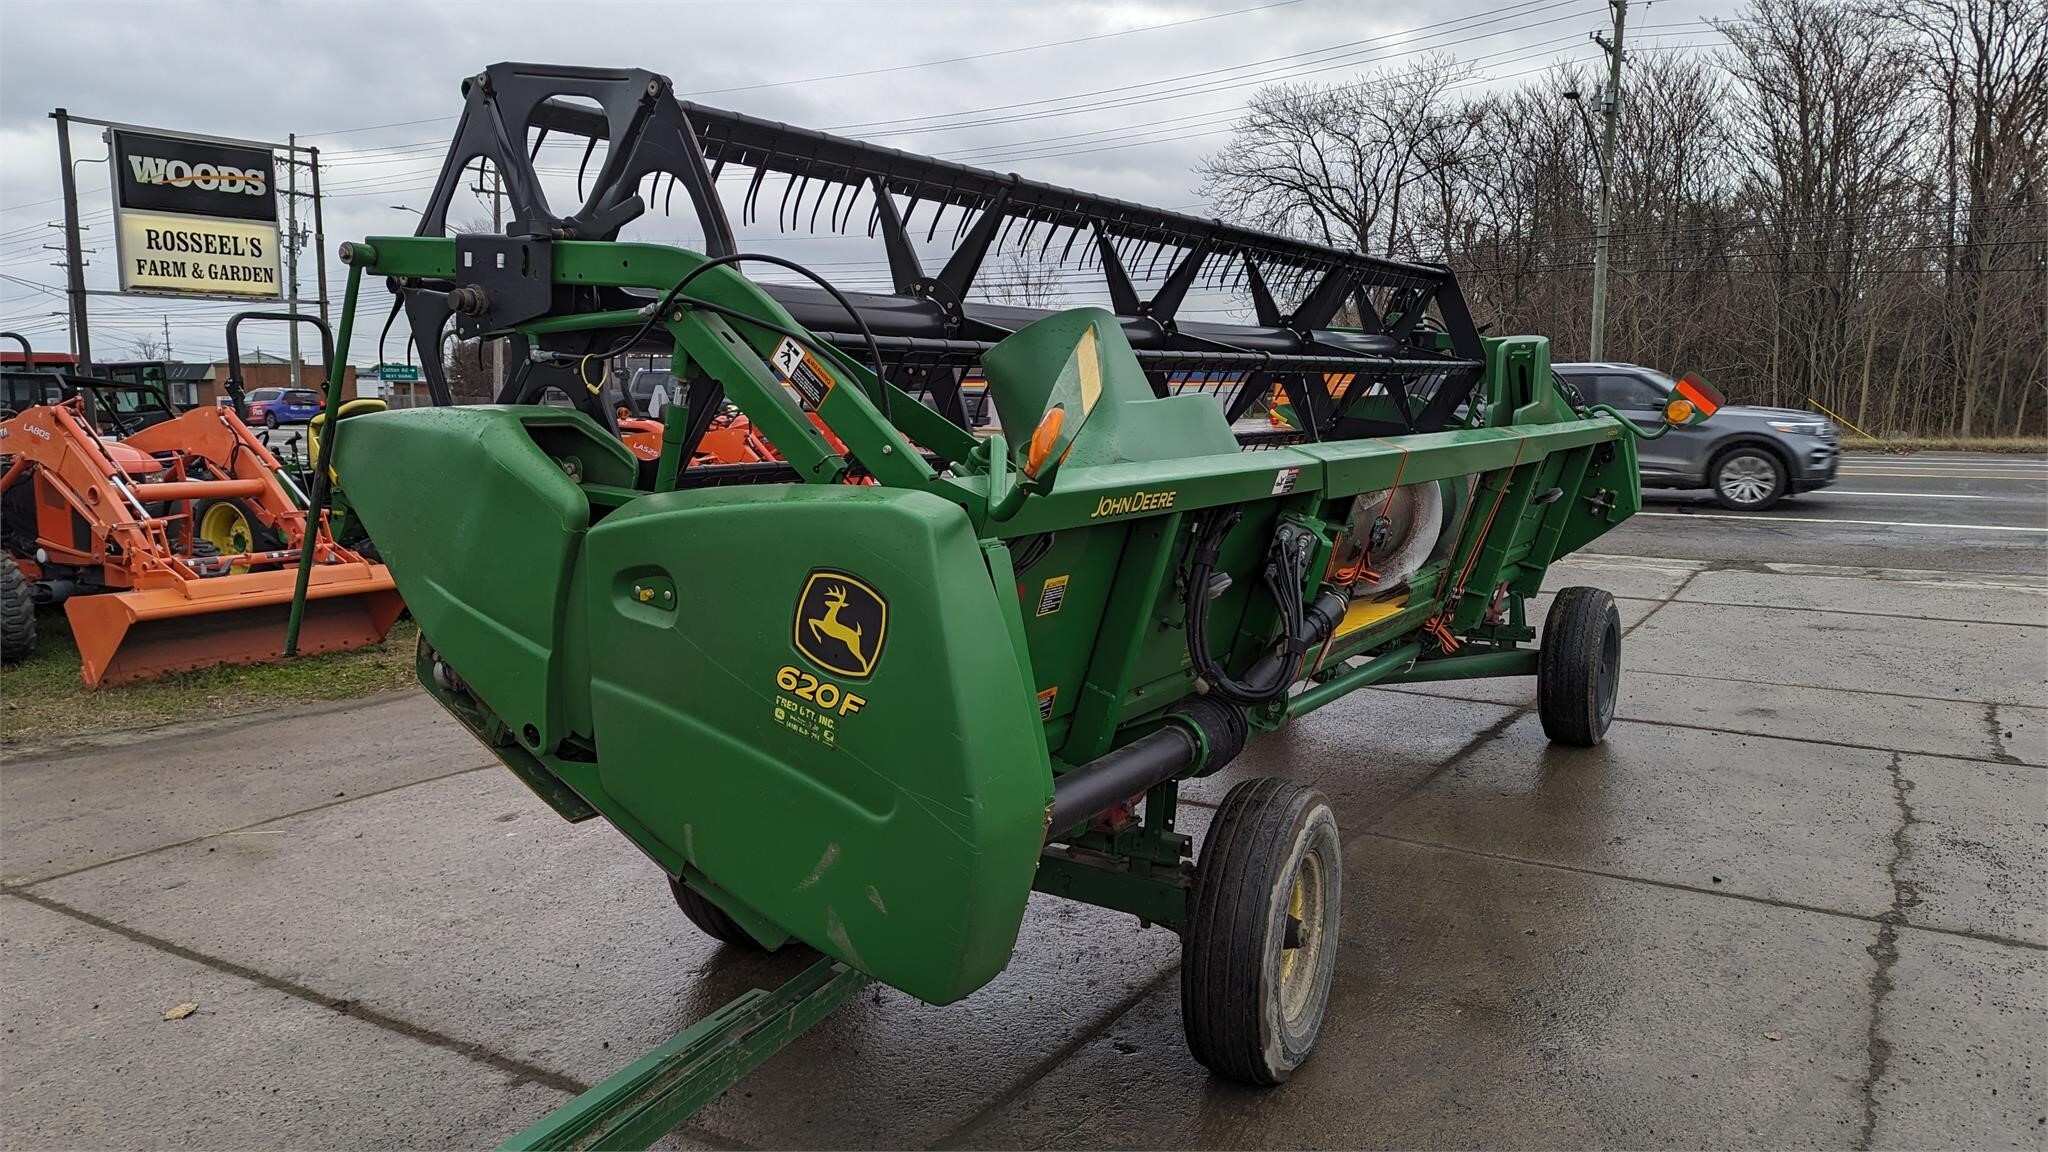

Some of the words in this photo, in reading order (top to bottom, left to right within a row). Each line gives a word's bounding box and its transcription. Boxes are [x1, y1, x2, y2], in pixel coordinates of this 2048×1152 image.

[128, 155, 267, 197] WOODS
[145, 229, 262, 258] ROSSEEL'S
[136, 258, 187, 278] FARM
[192, 262, 204, 279] &
[208, 263, 274, 284] GARDEN
[23, 423, 51, 441] LA805
[1091, 495, 1134, 518] JOHN
[1131, 491, 1177, 512] DEERE
[776, 665, 867, 717] 620F
[818, 714, 835, 730] INC.
